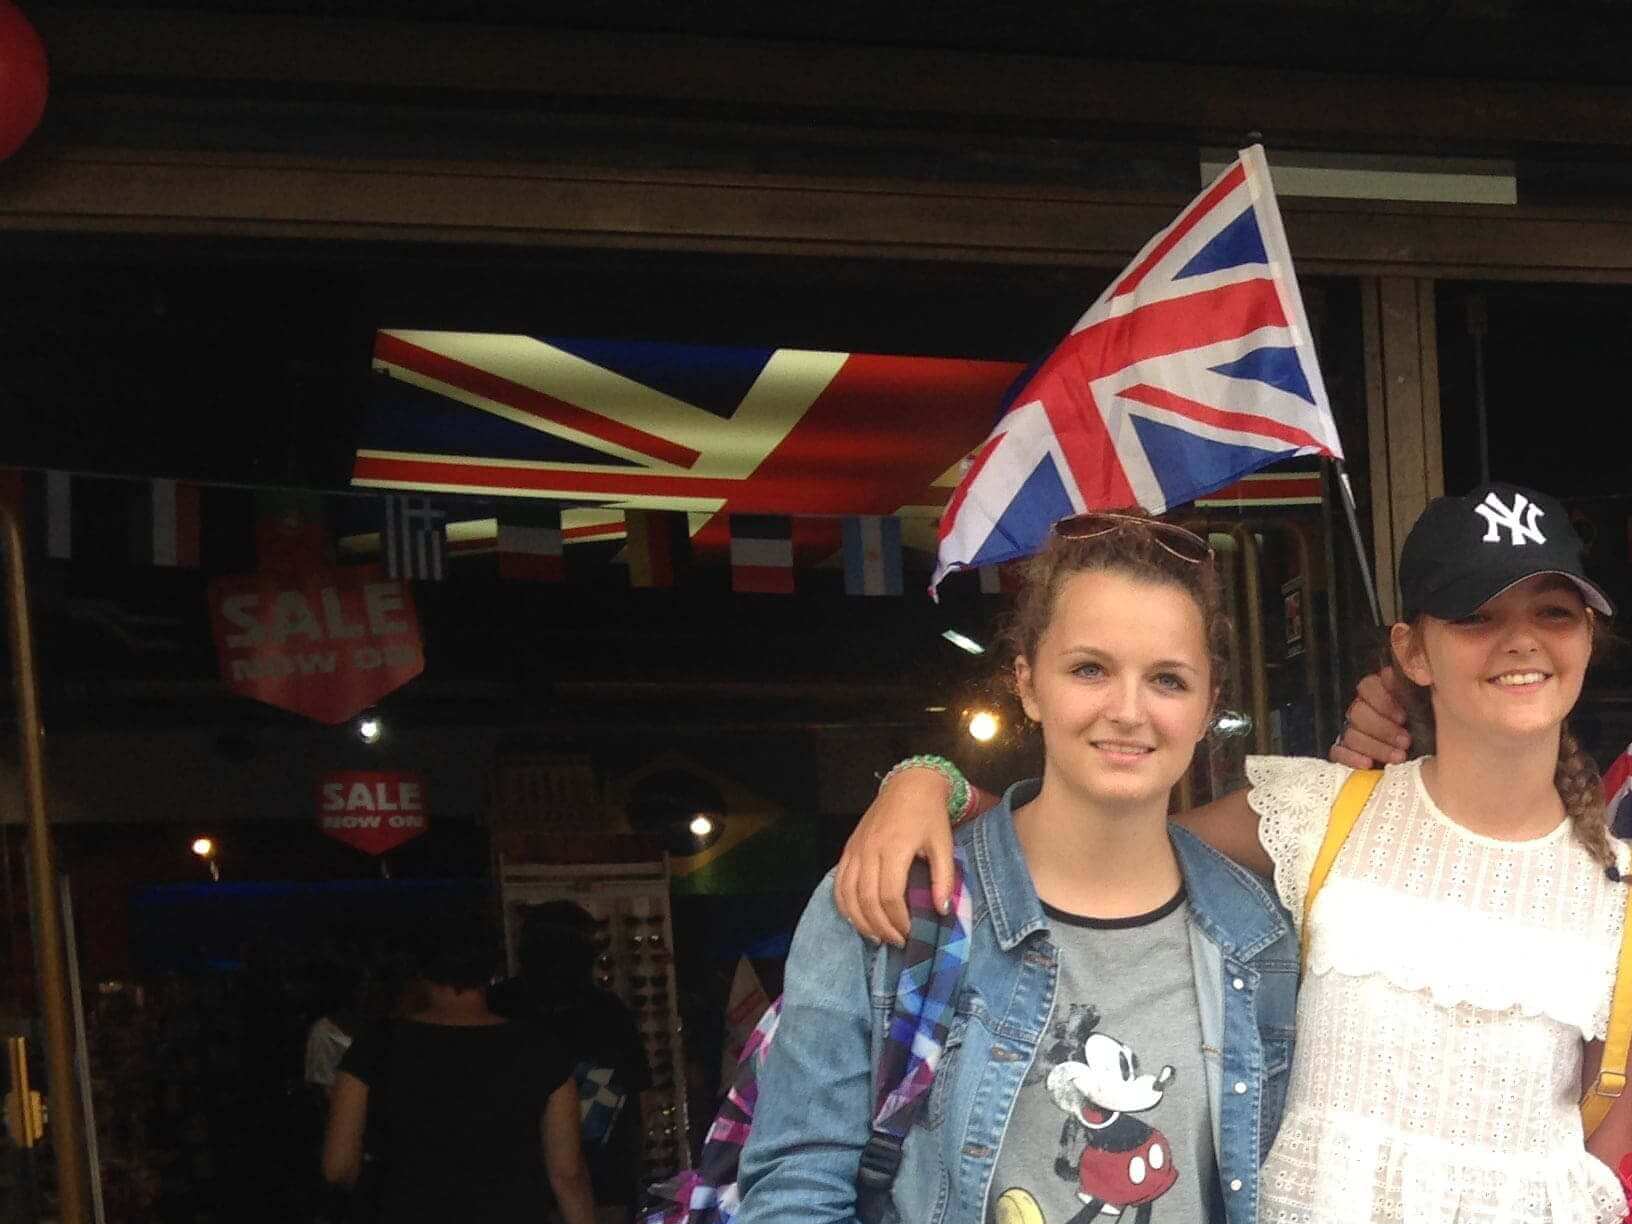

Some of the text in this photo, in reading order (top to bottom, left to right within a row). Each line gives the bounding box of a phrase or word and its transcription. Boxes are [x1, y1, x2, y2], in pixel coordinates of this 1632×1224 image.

[1474, 492, 1547, 546] NY
[222, 582, 409, 648] SALE
[230, 652, 337, 681] NOW
[322, 782, 422, 811] SALE
[322, 815, 425, 829] NOW ON
